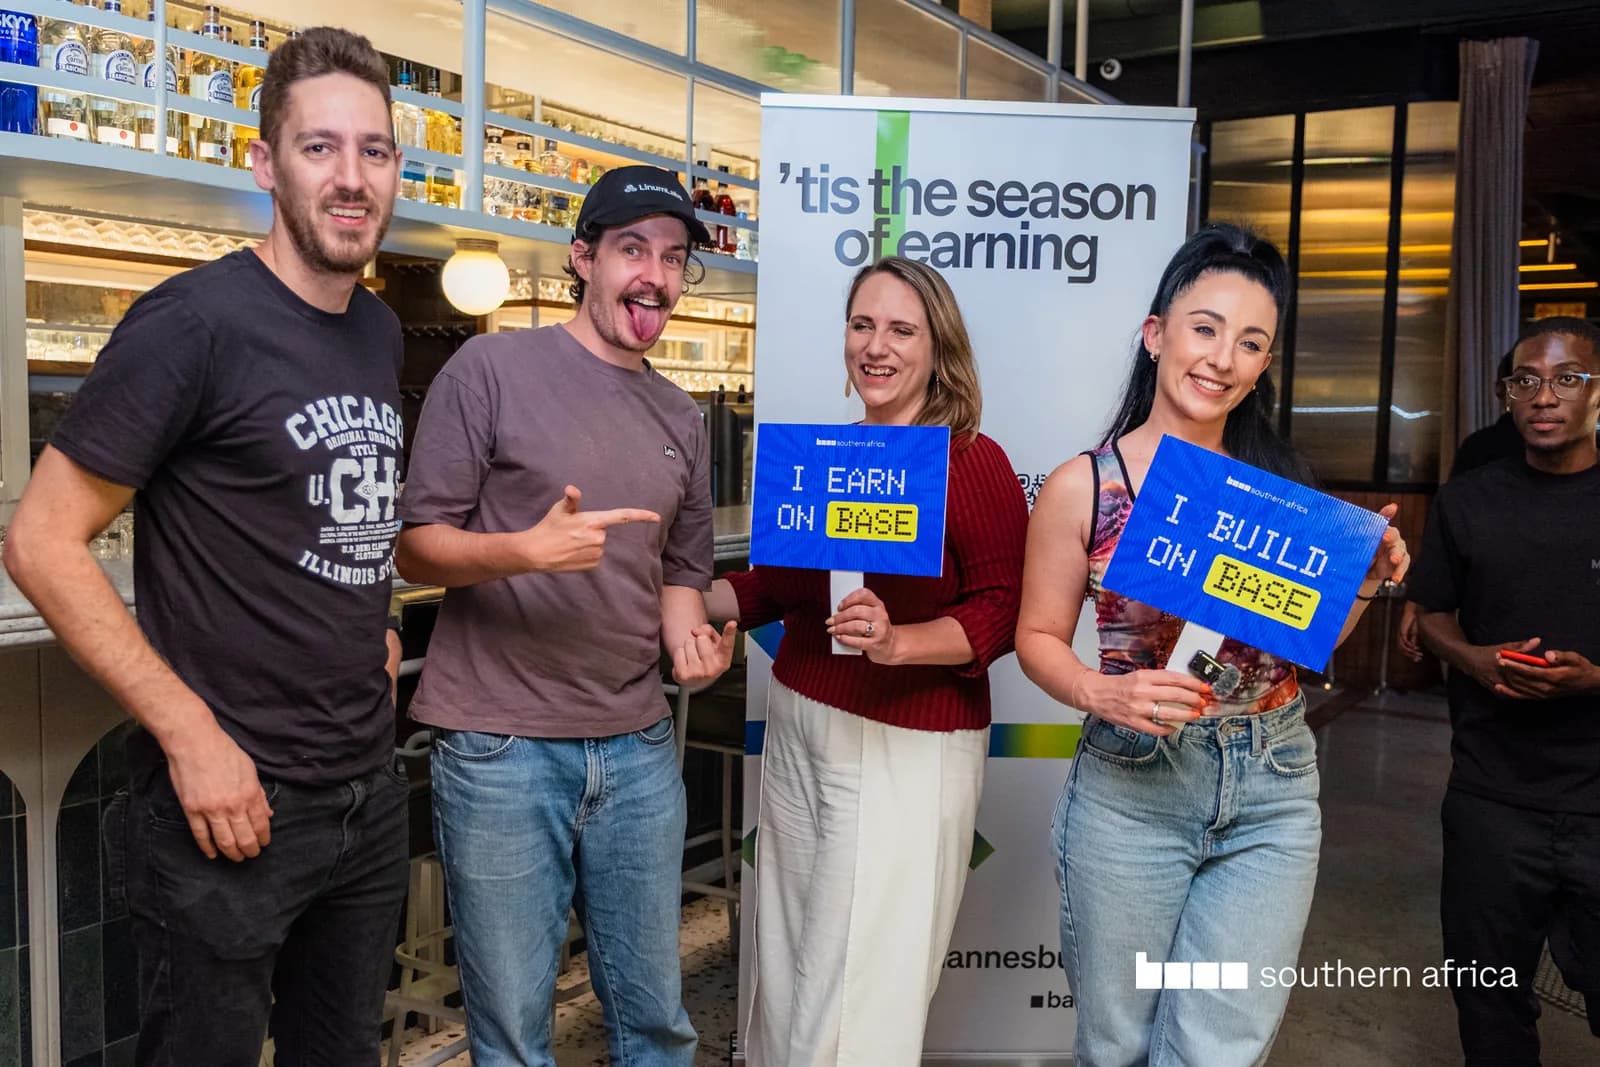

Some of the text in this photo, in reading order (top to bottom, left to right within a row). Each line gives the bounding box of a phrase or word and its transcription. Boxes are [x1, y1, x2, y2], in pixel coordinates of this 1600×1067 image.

[0, 13, 32, 31] KYY
[868, 165, 957, 217] the
[966, 179, 1157, 221] season
[834, 216, 1099, 284] of earning
[286, 395, 403, 450] CHICAGO
[325, 430, 395, 450] ORIGINAL URBAN
[350, 444, 378, 456] STYLE
[331, 456, 396, 524] CH
[792, 465, 906, 496] I EARN
[1250, 487, 1308, 515] southern africa
[777, 503, 912, 536] ON BASE
[1166, 494, 1329, 578] I BUILD
[299, 550, 376, 585] ILLINOIS
[1146, 535, 1312, 621] ON BASE
[943, 945, 1065, 969] annesb
